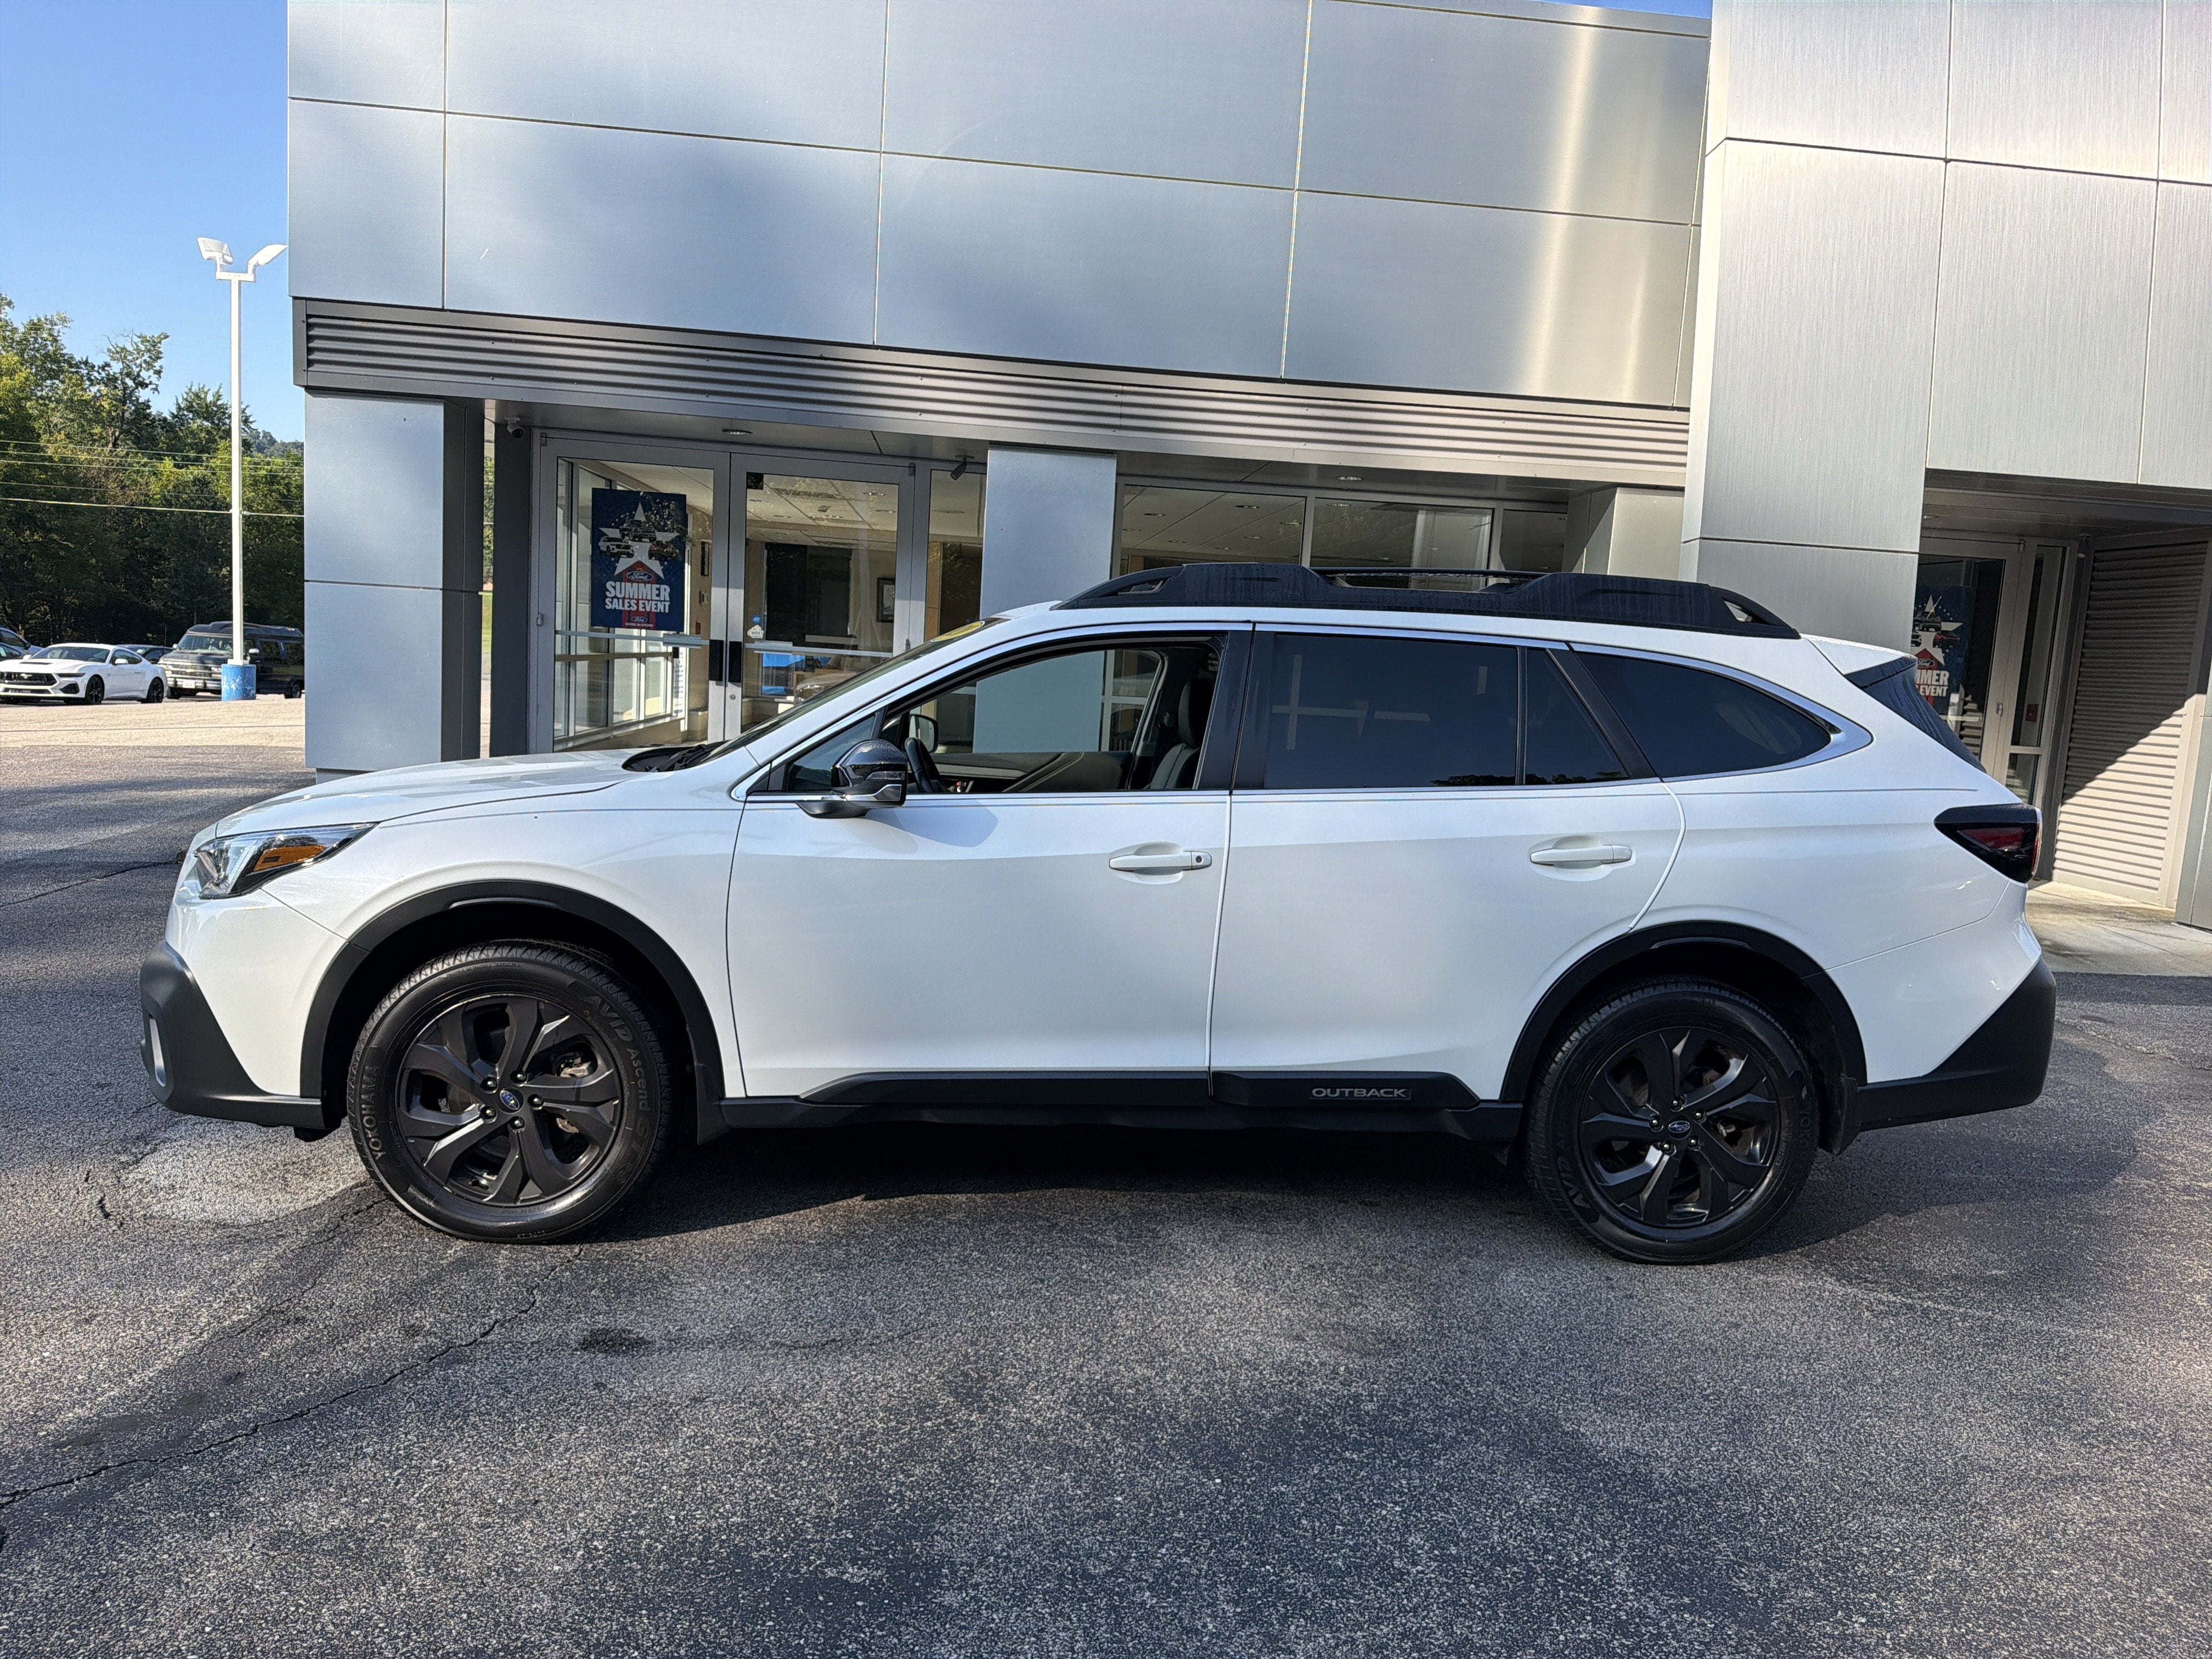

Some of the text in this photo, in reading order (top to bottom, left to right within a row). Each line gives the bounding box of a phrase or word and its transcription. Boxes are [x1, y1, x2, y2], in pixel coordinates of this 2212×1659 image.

[631, 572, 648, 580] Ford
[605, 580, 670, 601] SUMMER
[605, 597, 670, 613] SALES EVENT
[1919, 685, 1948, 697] EVENT
[1312, 1088, 1407, 1098] OUTBACK
[360, 1065, 387, 1161] YOKOHAMA
